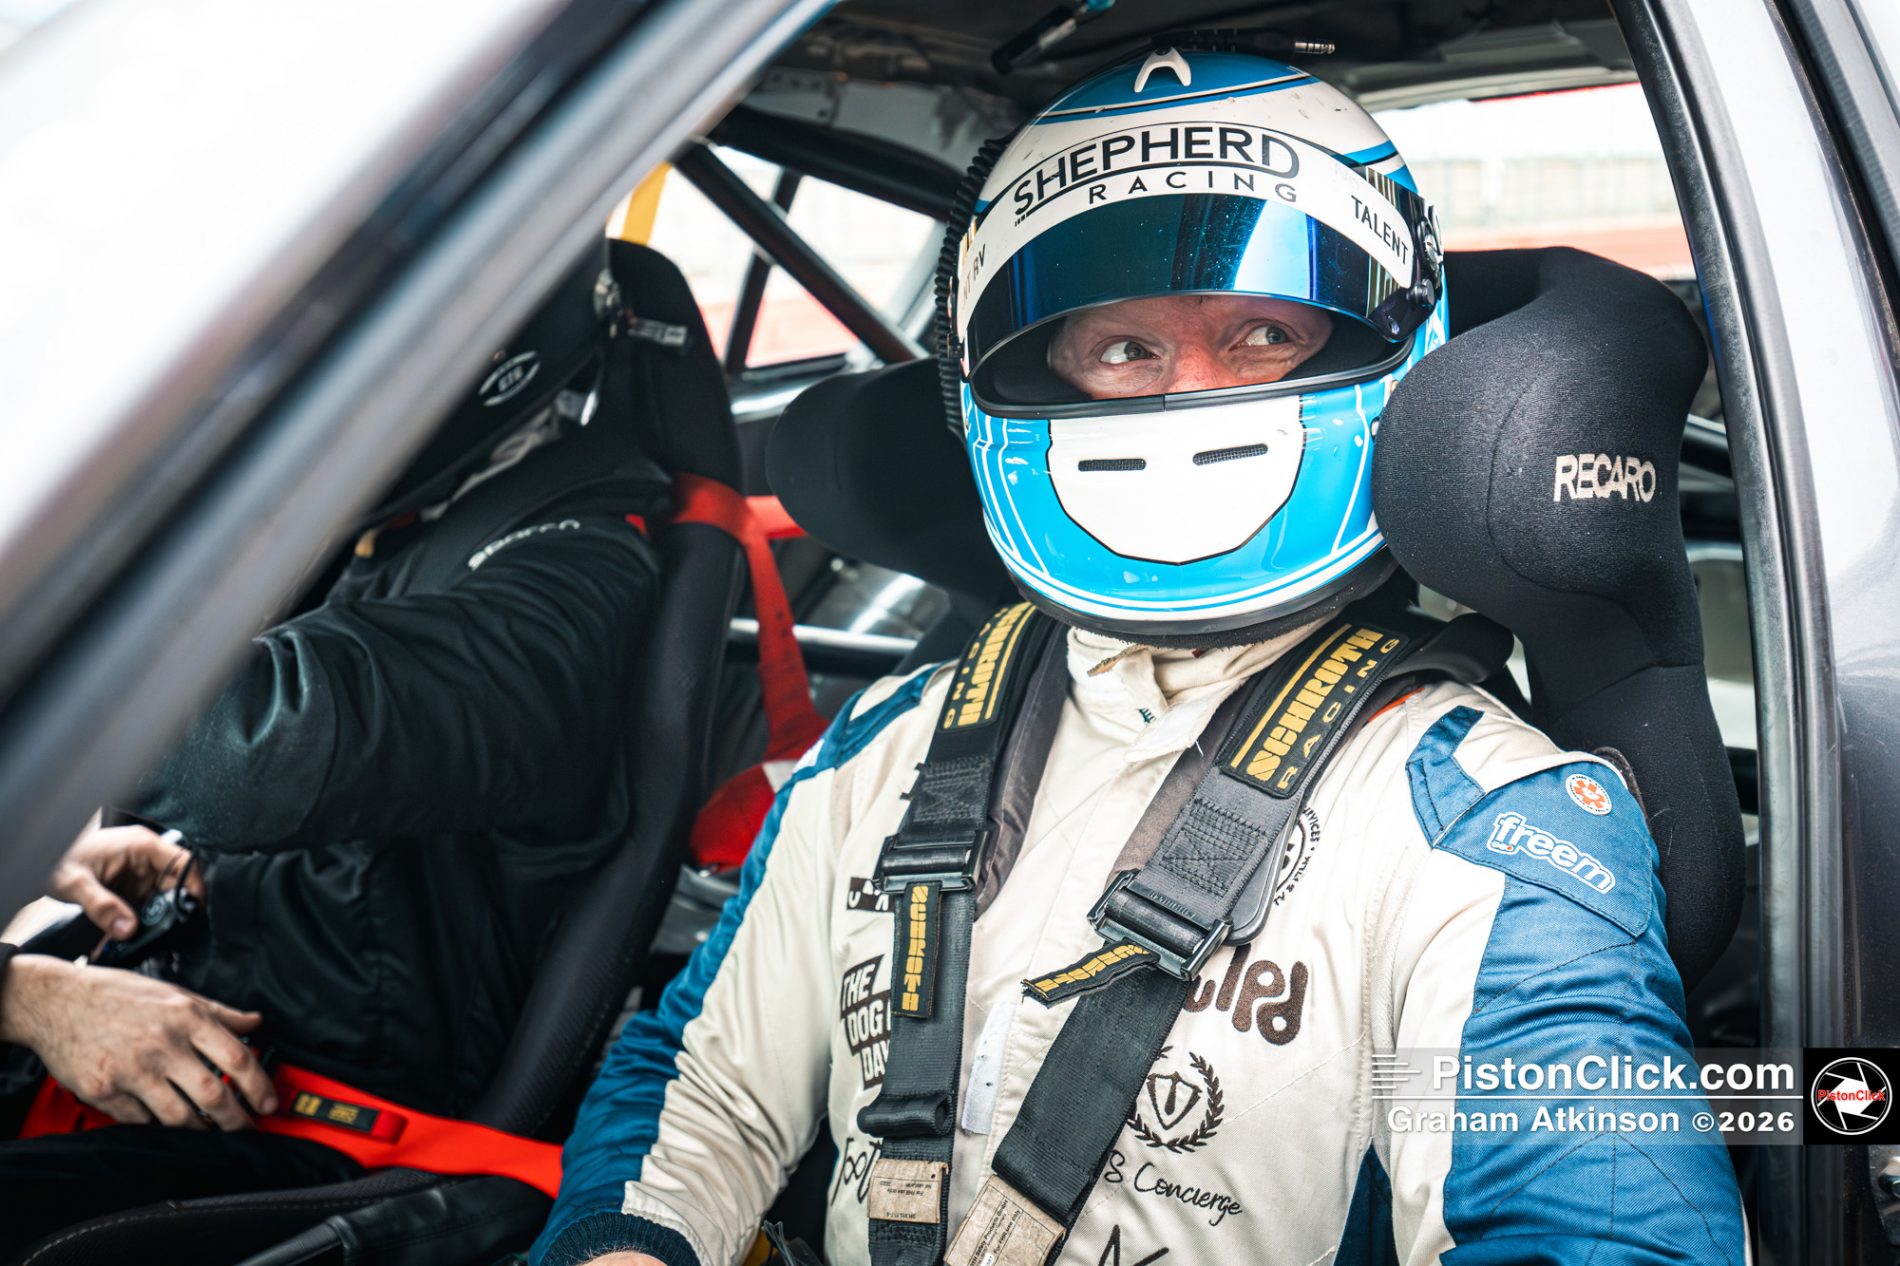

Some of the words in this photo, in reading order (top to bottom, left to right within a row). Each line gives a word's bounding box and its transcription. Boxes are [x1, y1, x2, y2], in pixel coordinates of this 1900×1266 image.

[1014, 126, 1300, 216] SHEPHERD
[1089, 170, 1297, 204] RACING
[1351, 194, 1408, 265] TALENT
[1552, 453, 1657, 503] RECARO
[1246, 627, 1384, 782] SCHROTH
[1277, 638, 1400, 790] RACING
[1493, 813, 1612, 892] freem
[901, 885, 929, 1011] SCHROTH
[842, 963, 876, 1012] THE
[846, 999, 884, 1048] DOG
[1183, 942, 1309, 1046] ulpd
[1134, 1162, 1243, 1227] Concierge
